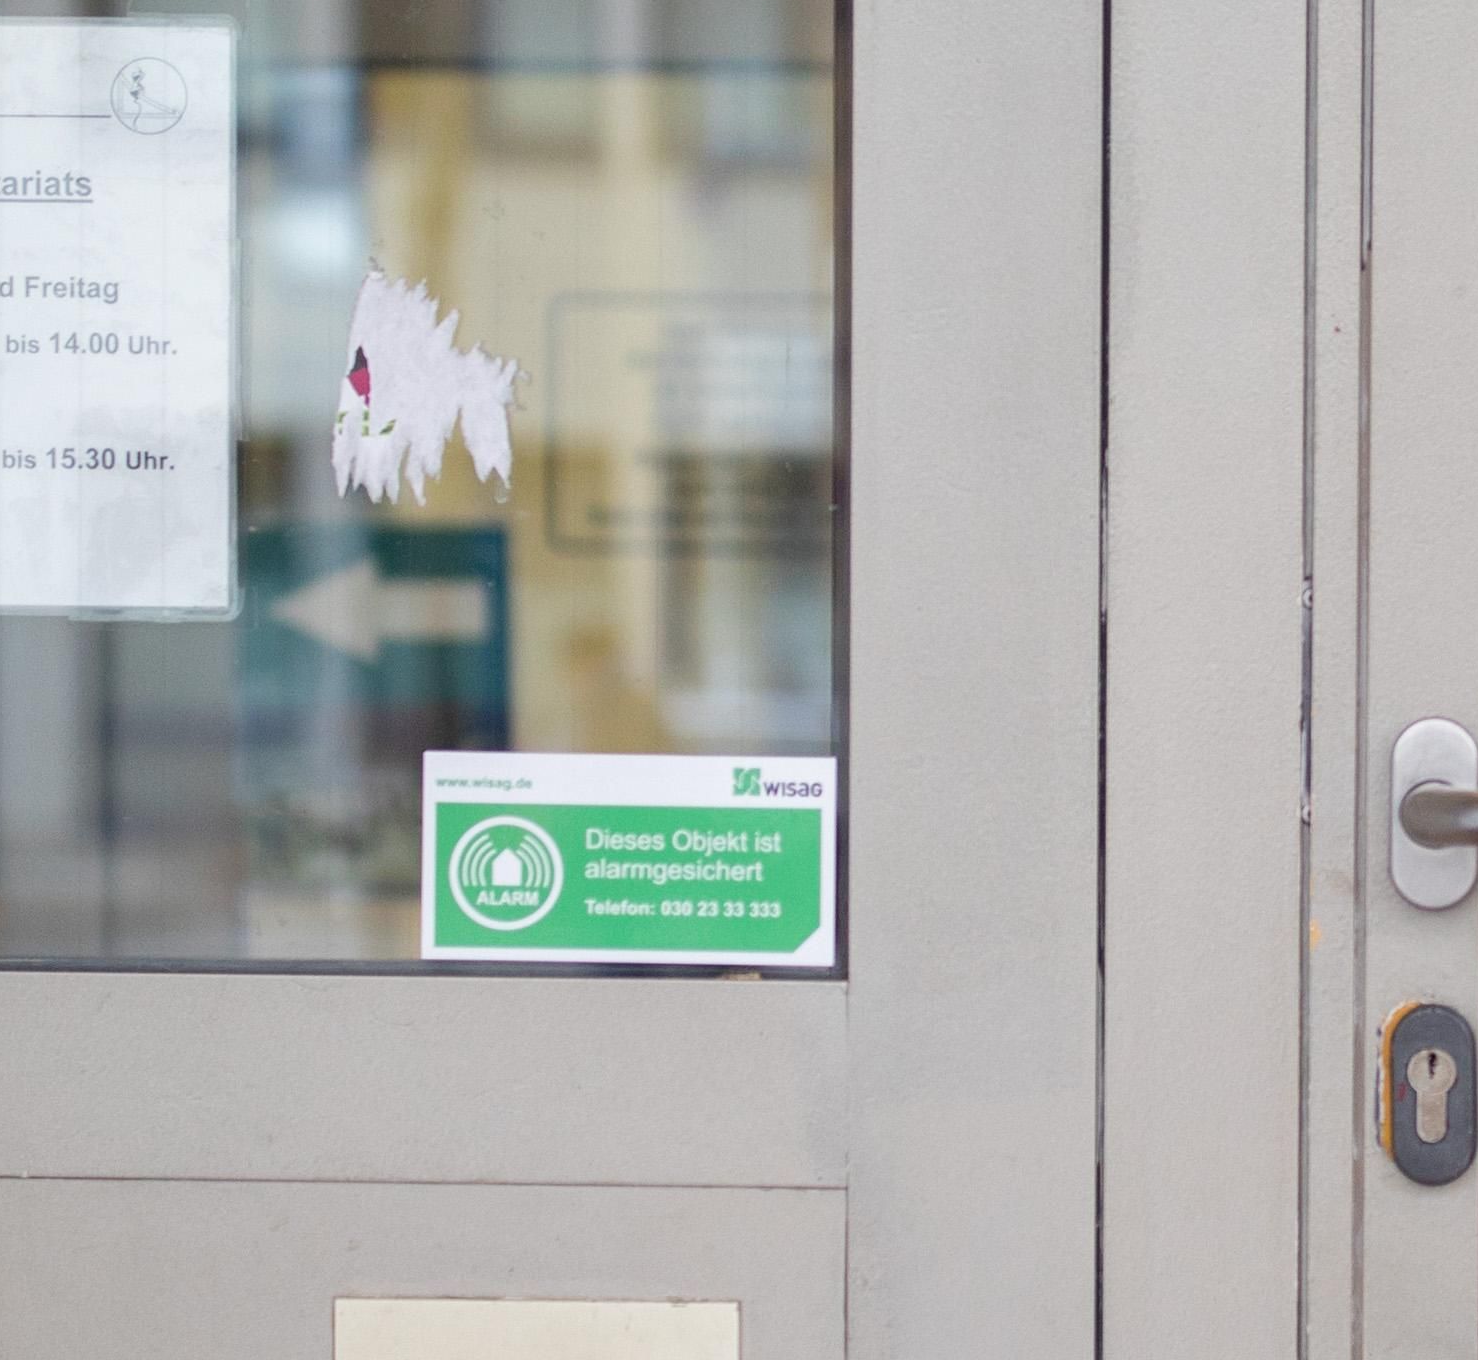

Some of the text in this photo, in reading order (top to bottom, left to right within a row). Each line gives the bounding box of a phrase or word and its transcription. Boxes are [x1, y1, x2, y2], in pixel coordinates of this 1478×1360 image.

[24, 276, 120, 304] Freitag
[5, 335, 40, 354] bis
[49, 332, 119, 355] 14.00
[128, 335, 177, 355] Uhr.
[2, 449, 37, 470] bis
[46, 447, 115, 471] 15.30
[126, 450, 175, 471] Uhr.
[436, 777, 533, 791] www.wisag.de
[585, 827, 782, 857] Dieses Objekt ist
[584, 857, 763, 885] alarmgesichert
[476, 890, 540, 906] ALARM
[584, 898, 655, 916] Telefon:
[697, 900, 719, 918] 23
